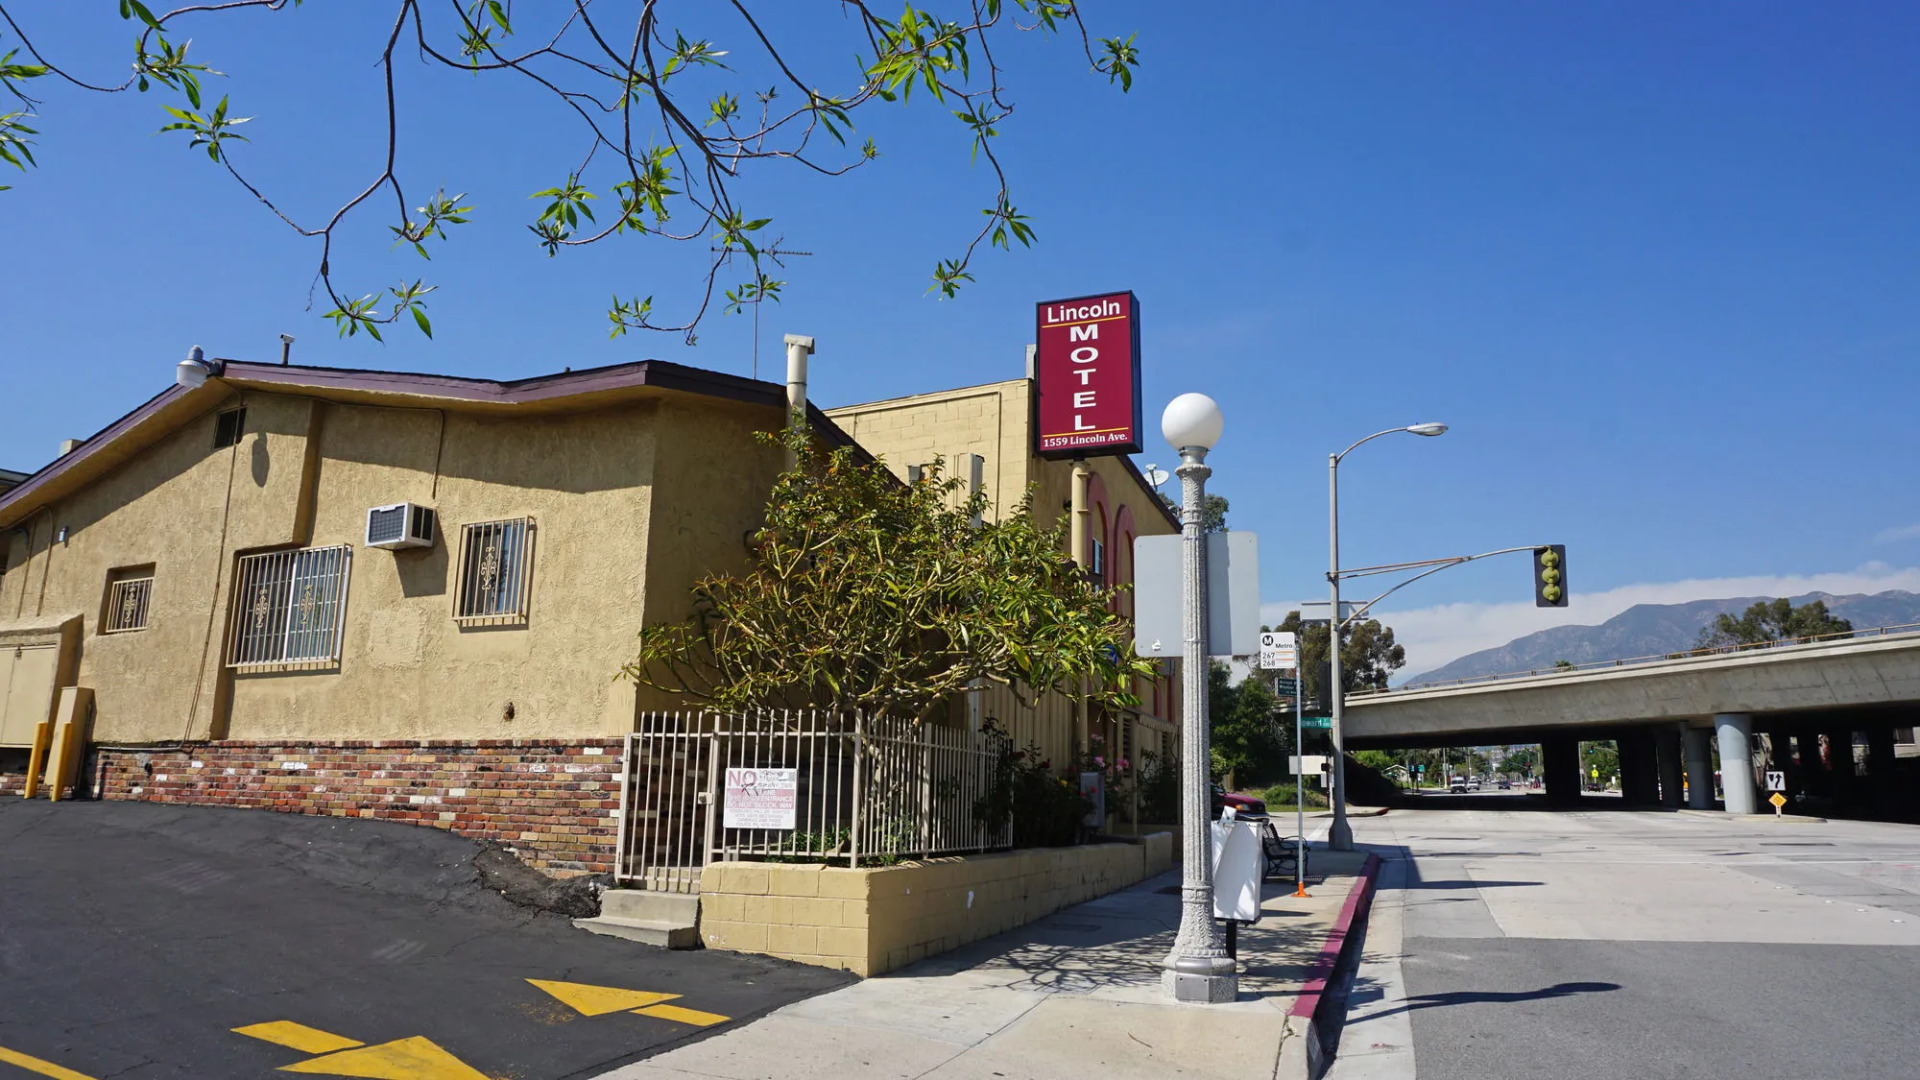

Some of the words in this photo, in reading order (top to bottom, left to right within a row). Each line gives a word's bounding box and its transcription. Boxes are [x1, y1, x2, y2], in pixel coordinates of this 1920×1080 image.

[1047, 299, 1121, 323] Lincoln
[1070, 323, 1098, 431] MOTEL
[1043, 437, 1068, 447] 1559
[1070, 433, 1106, 445] Lincoln
[1107, 432, 1128, 442] Ave.
[1262, 652, 1276, 660] 267
[728, 770, 757, 787] NO
